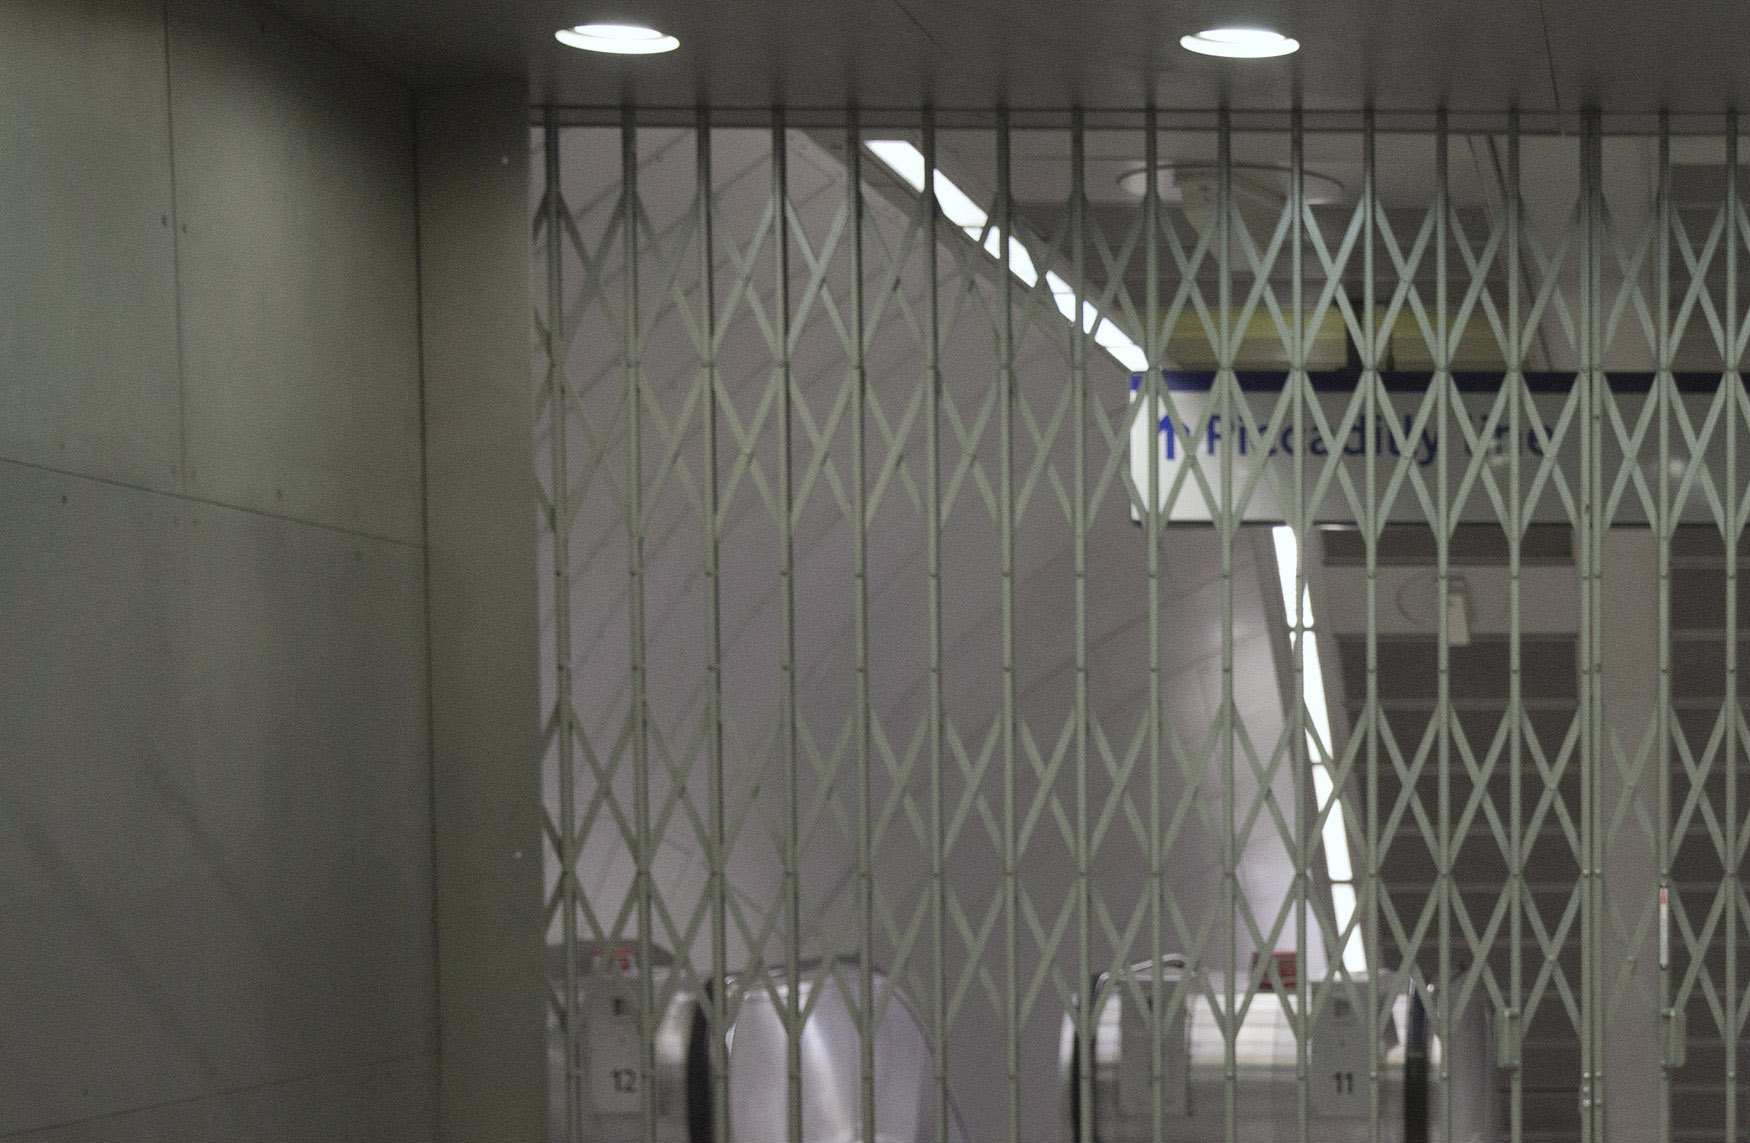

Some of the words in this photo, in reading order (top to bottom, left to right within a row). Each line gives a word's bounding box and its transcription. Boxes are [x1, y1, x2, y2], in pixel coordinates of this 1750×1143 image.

[1464, 413, 1554, 456] ne
[610, 1068, 638, 1094] 12
[1333, 1071, 1354, 1095] 11
